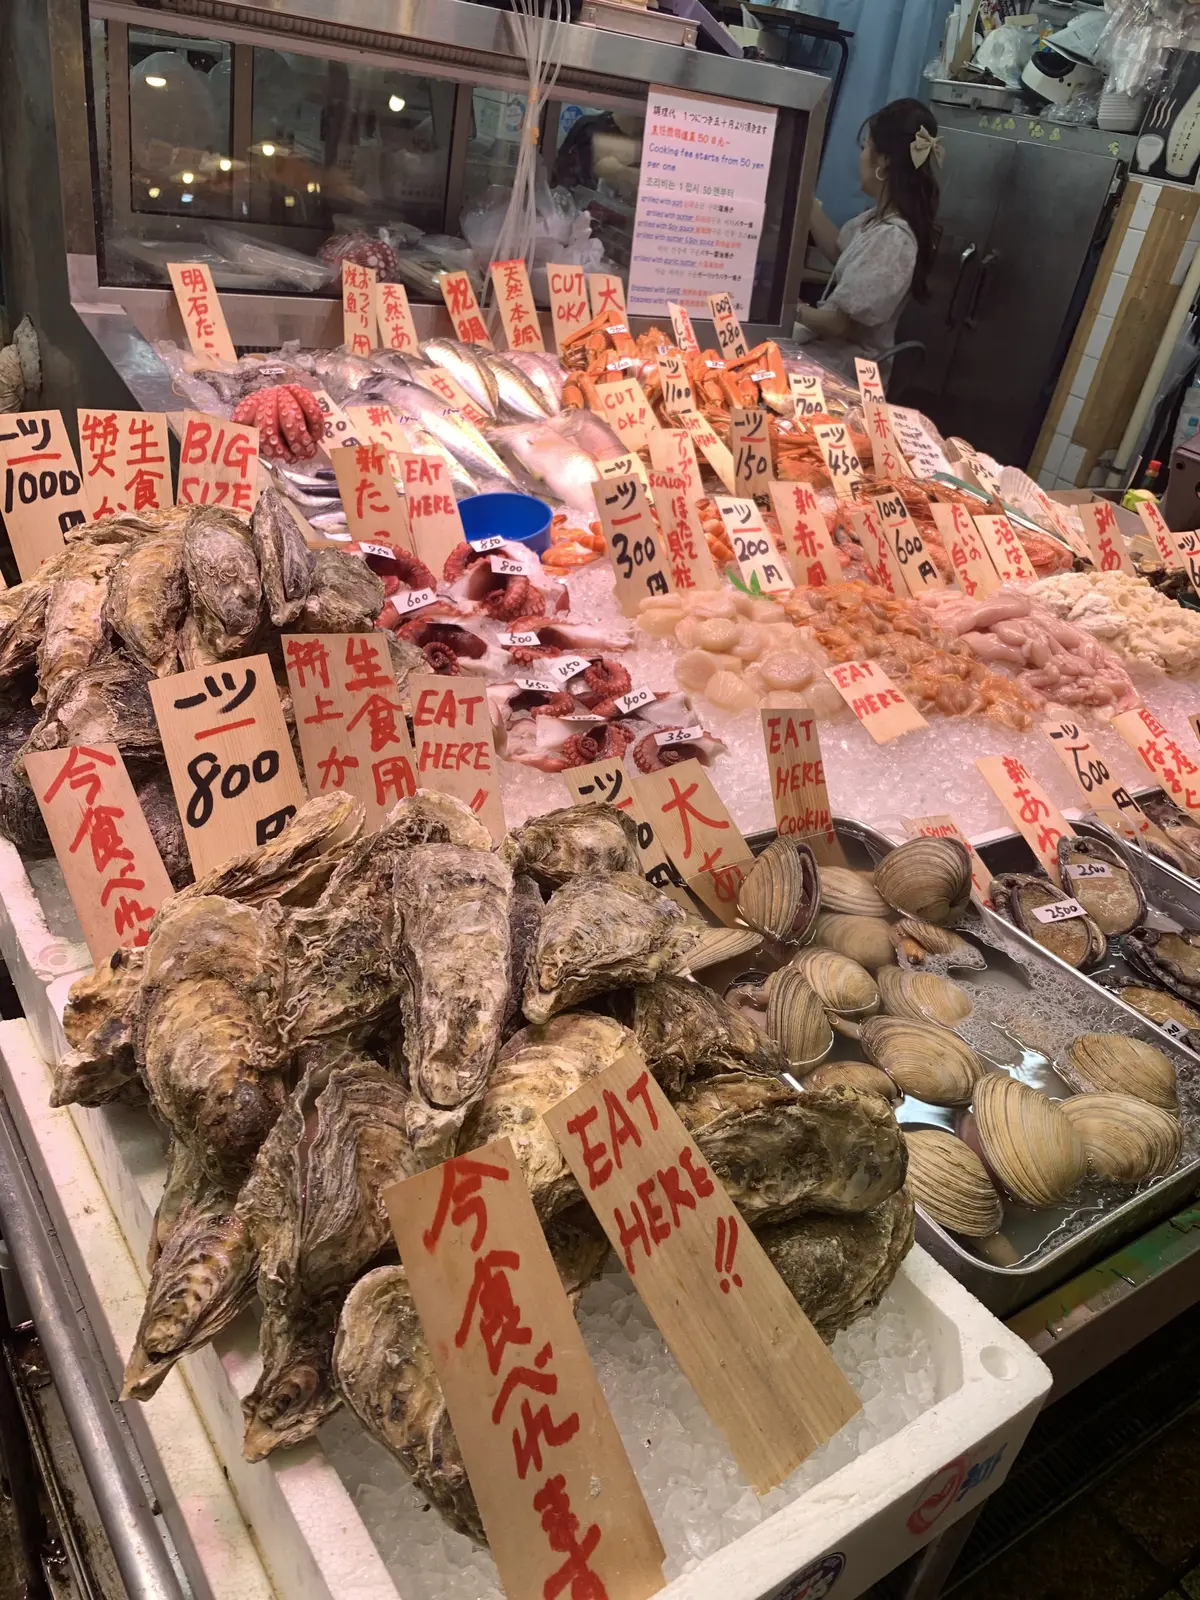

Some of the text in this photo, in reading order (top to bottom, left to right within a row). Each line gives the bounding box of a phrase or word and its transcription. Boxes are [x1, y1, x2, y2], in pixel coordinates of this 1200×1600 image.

[653, 105, 676, 119] 調理代
[647, 161, 676, 171] per one
[649, 143, 764, 170] Cooking fee starts from 50 yen
[645, 177, 675, 190] 조리비는
[703, 186, 711, 195] 50
[664, 211, 676, 219] with
[551, 273, 583, 296] CUT
[597, 278, 624, 315] 大
[383, 285, 411, 349] 天然あ
[711, 296, 732, 317] 100g
[719, 322, 740, 348] 280
[604, 388, 634, 409] CUT
[665, 381, 692, 403] 1100
[796, 398, 823, 416] 700
[681, 416, 702, 430] EAT
[181, 420, 257, 478] BIG
[404, 458, 443, 486] EAT
[736, 445, 767, 481] 150
[828, 450, 859, 476] 450
[4, 468, 82, 514] 1000
[178, 478, 253, 513] SIZE
[409, 495, 455, 518] HERE
[876, 497, 907, 520] 100g
[672, 497, 698, 559] ほたて
[612, 533, 656, 580] 300
[734, 537, 769, 563] 200
[896, 528, 922, 564] 600
[500, 561, 522, 572] 800
[407, 593, 428, 608] 600
[509, 632, 532, 644] 500
[558, 660, 580, 677] 450
[832, 663, 874, 689] EAT
[413, 689, 483, 728] EAT
[623, 691, 647, 709] 400
[852, 688, 904, 719] HERE
[665, 732, 691, 741] 350
[767, 717, 813, 754] EAT
[419, 741, 491, 772] HERE
[775, 760, 825, 800] HERE
[1073, 750, 1110, 792] 600
[186, 749, 280, 829] 800
[1077, 864, 1105, 876] 2500
[1045, 905, 1079, 919] 2500
[567, 1071, 662, 1190] EAT
[613, 1147, 715, 1274] HERE
[714, 1215, 744, 1294] !!
